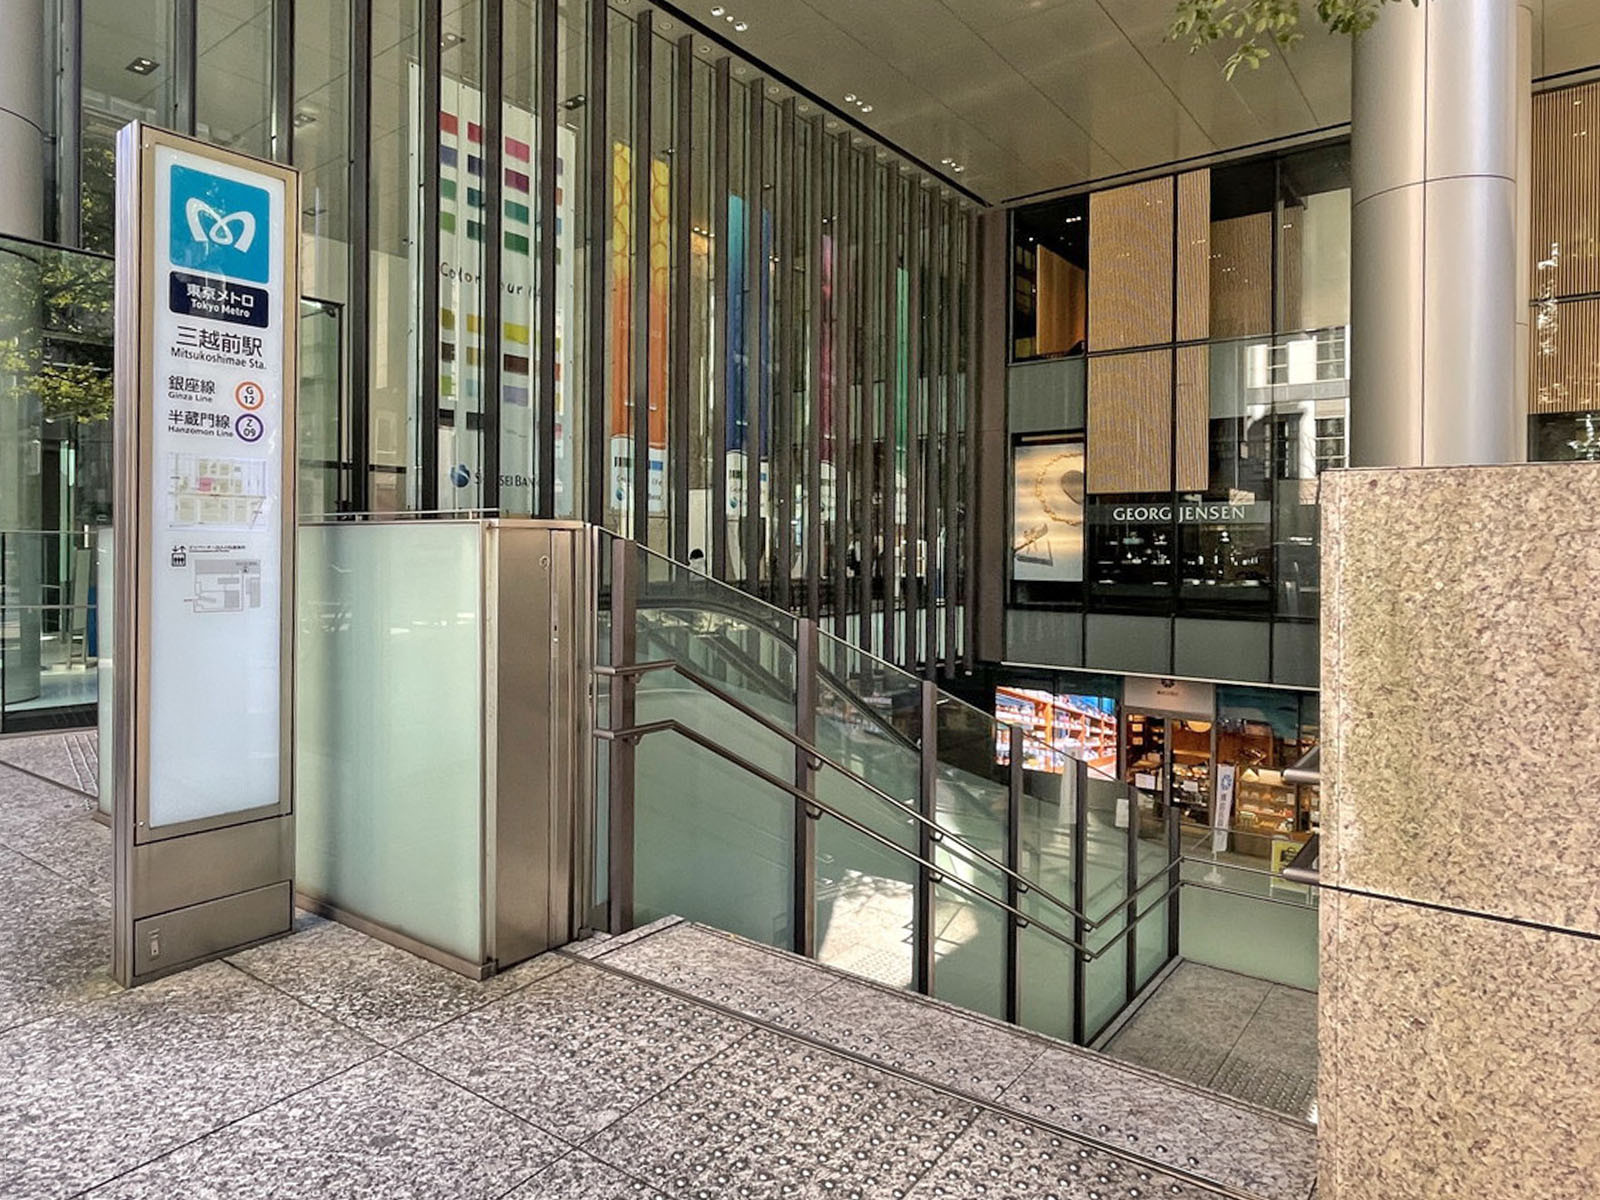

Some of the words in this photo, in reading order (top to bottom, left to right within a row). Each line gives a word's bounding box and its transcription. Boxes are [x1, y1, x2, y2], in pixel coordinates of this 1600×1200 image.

[186, 283, 254, 308] 東京メトロ
[190, 298, 219, 313] Tokyo
[221, 304, 250, 317] Metro
[176, 325, 263, 358] 三越前駅
[170, 346, 247, 367] Mitsukoshimae
[248, 358, 267, 370] Sta.
[168, 375, 215, 395] 銀座線
[245, 386, 254, 395] G
[168, 391, 193, 401] Ginza
[195, 394, 213, 403] Line
[243, 395, 255, 405] 12
[168, 409, 230, 429] 半蔵門線
[246, 418, 253, 428] Z
[168, 425, 215, 437] Hanzomon
[216, 429, 234, 438] Line
[243, 427, 256, 437] 09
[1112, 507, 1172, 521] GEORG
[1178, 506, 1246, 523] JENSEN
